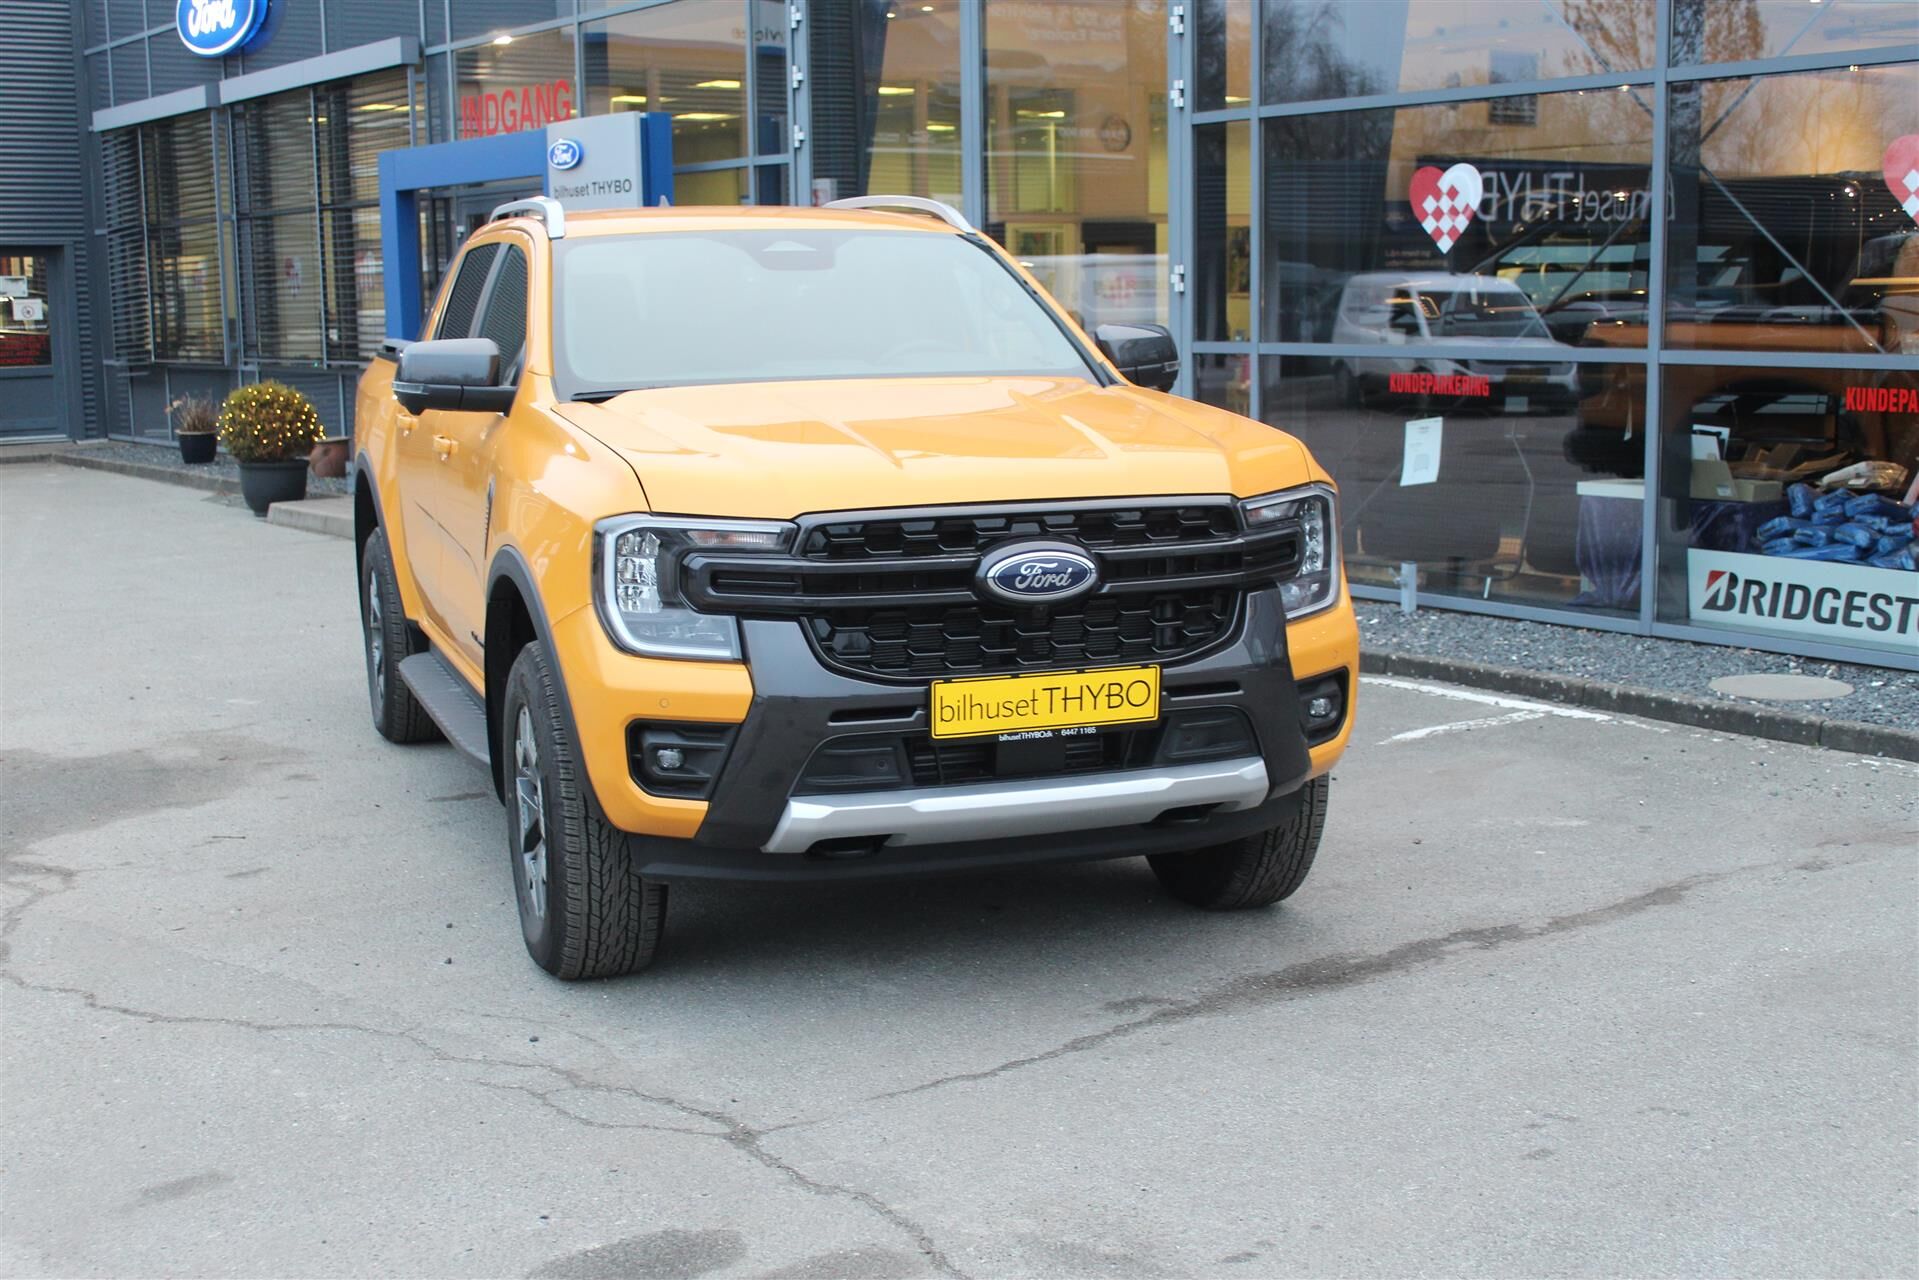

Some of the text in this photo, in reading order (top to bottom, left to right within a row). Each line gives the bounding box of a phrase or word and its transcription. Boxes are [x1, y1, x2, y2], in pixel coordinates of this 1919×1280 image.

[462, 79, 572, 139] INDGANG
[554, 178, 633, 199] bilhuset THYBO
[1389, 371, 1490, 397] KUNDEPARKERING
[1845, 386, 1919, 413] KUNDEPA
[1015, 561, 1072, 590] Ford
[1702, 569, 1919, 635] BRIDGEST
[939, 680, 1151, 723] bilhuset THYBO
